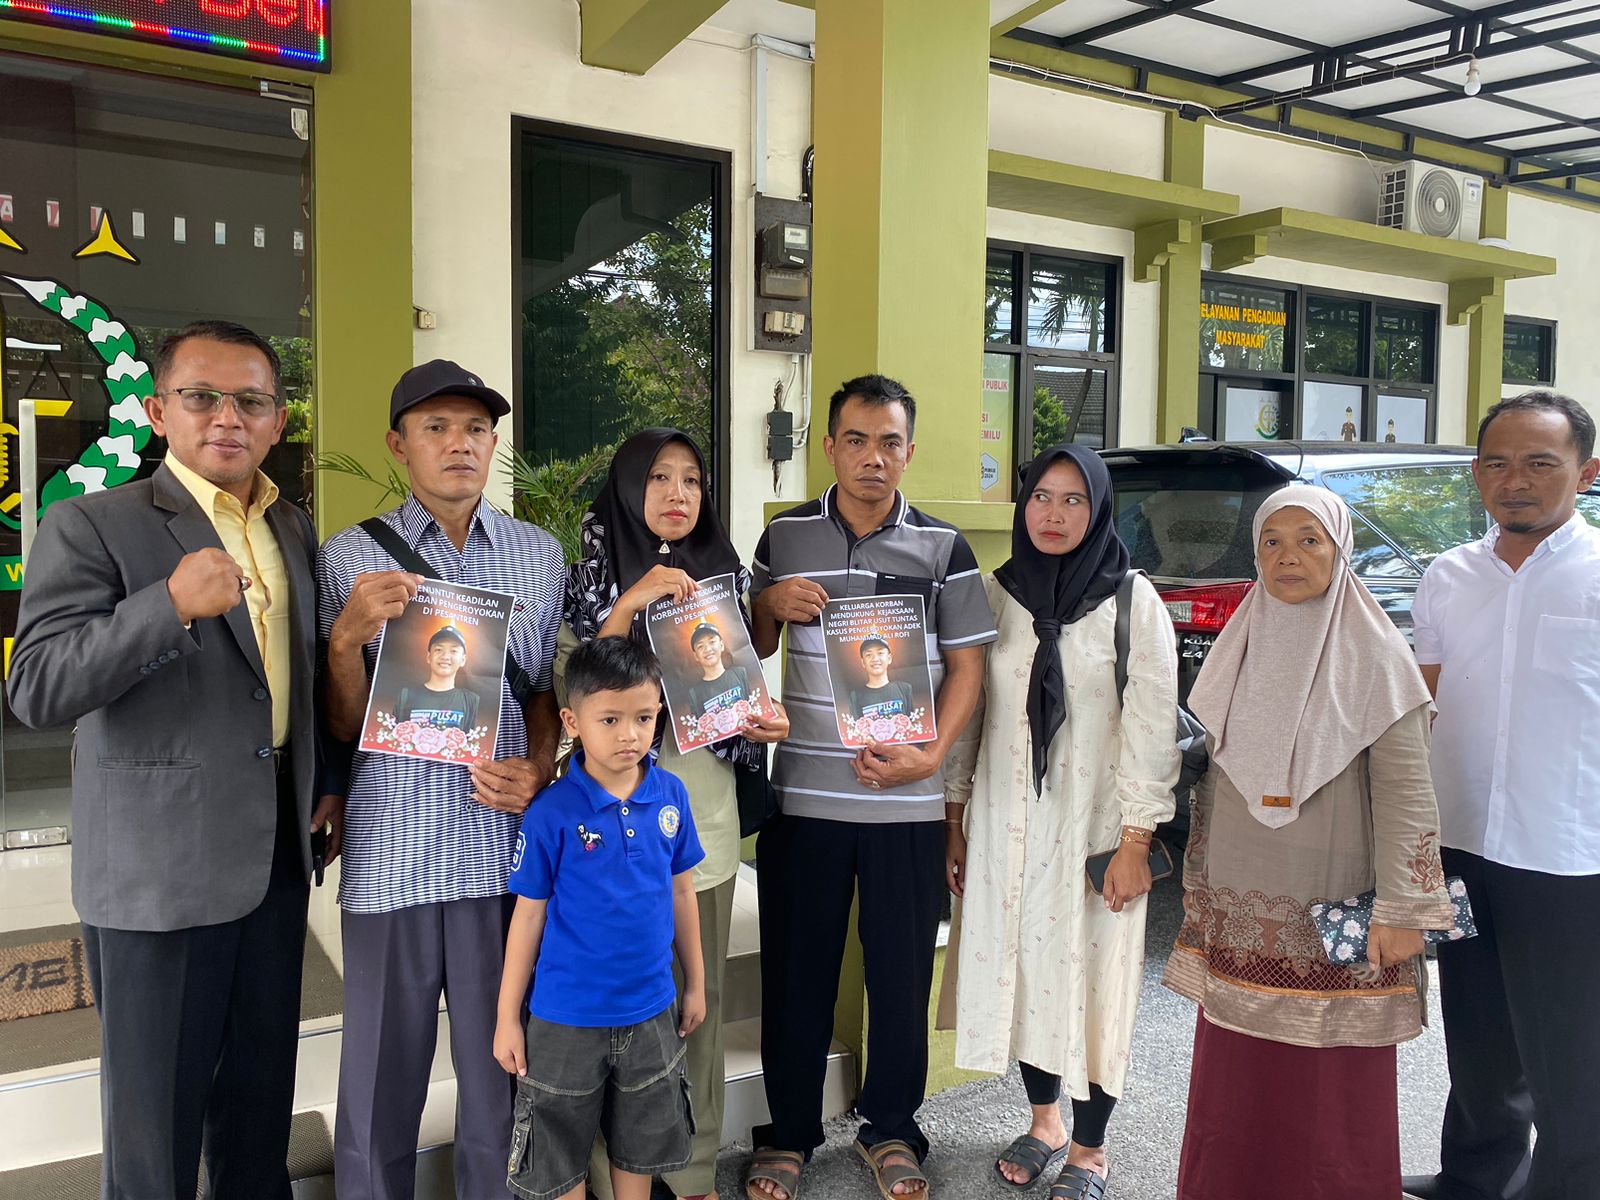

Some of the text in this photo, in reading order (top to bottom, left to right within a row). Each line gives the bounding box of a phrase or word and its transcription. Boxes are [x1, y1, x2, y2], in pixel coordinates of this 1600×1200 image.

[1200, 303, 1287, 326] ELAYANAN PENGADUAN
[1215, 330, 1266, 349] MASYARAKAT
[985, 380, 1009, 390] PUBLIK
[416, 584, 499, 608] ENUNTUT KEADILAN
[408, 594, 505, 620] RBAN PENGEROYOKAN
[839, 600, 904, 611] KELUARGA KORBAN
[422, 606, 479, 626] DI PESANTREN
[651, 606, 684, 622] KORBAN
[830, 607, 914, 620] MENDUKUNG KEJAKSAAN
[674, 616, 683, 625] DI
[828, 620, 849, 628] NEGRI
[826, 622, 921, 636] KASUS PENGEROYOKAN ADEK
[839, 634, 882, 643] MUHAMMAD
[430, 711, 464, 722] PUSAT
